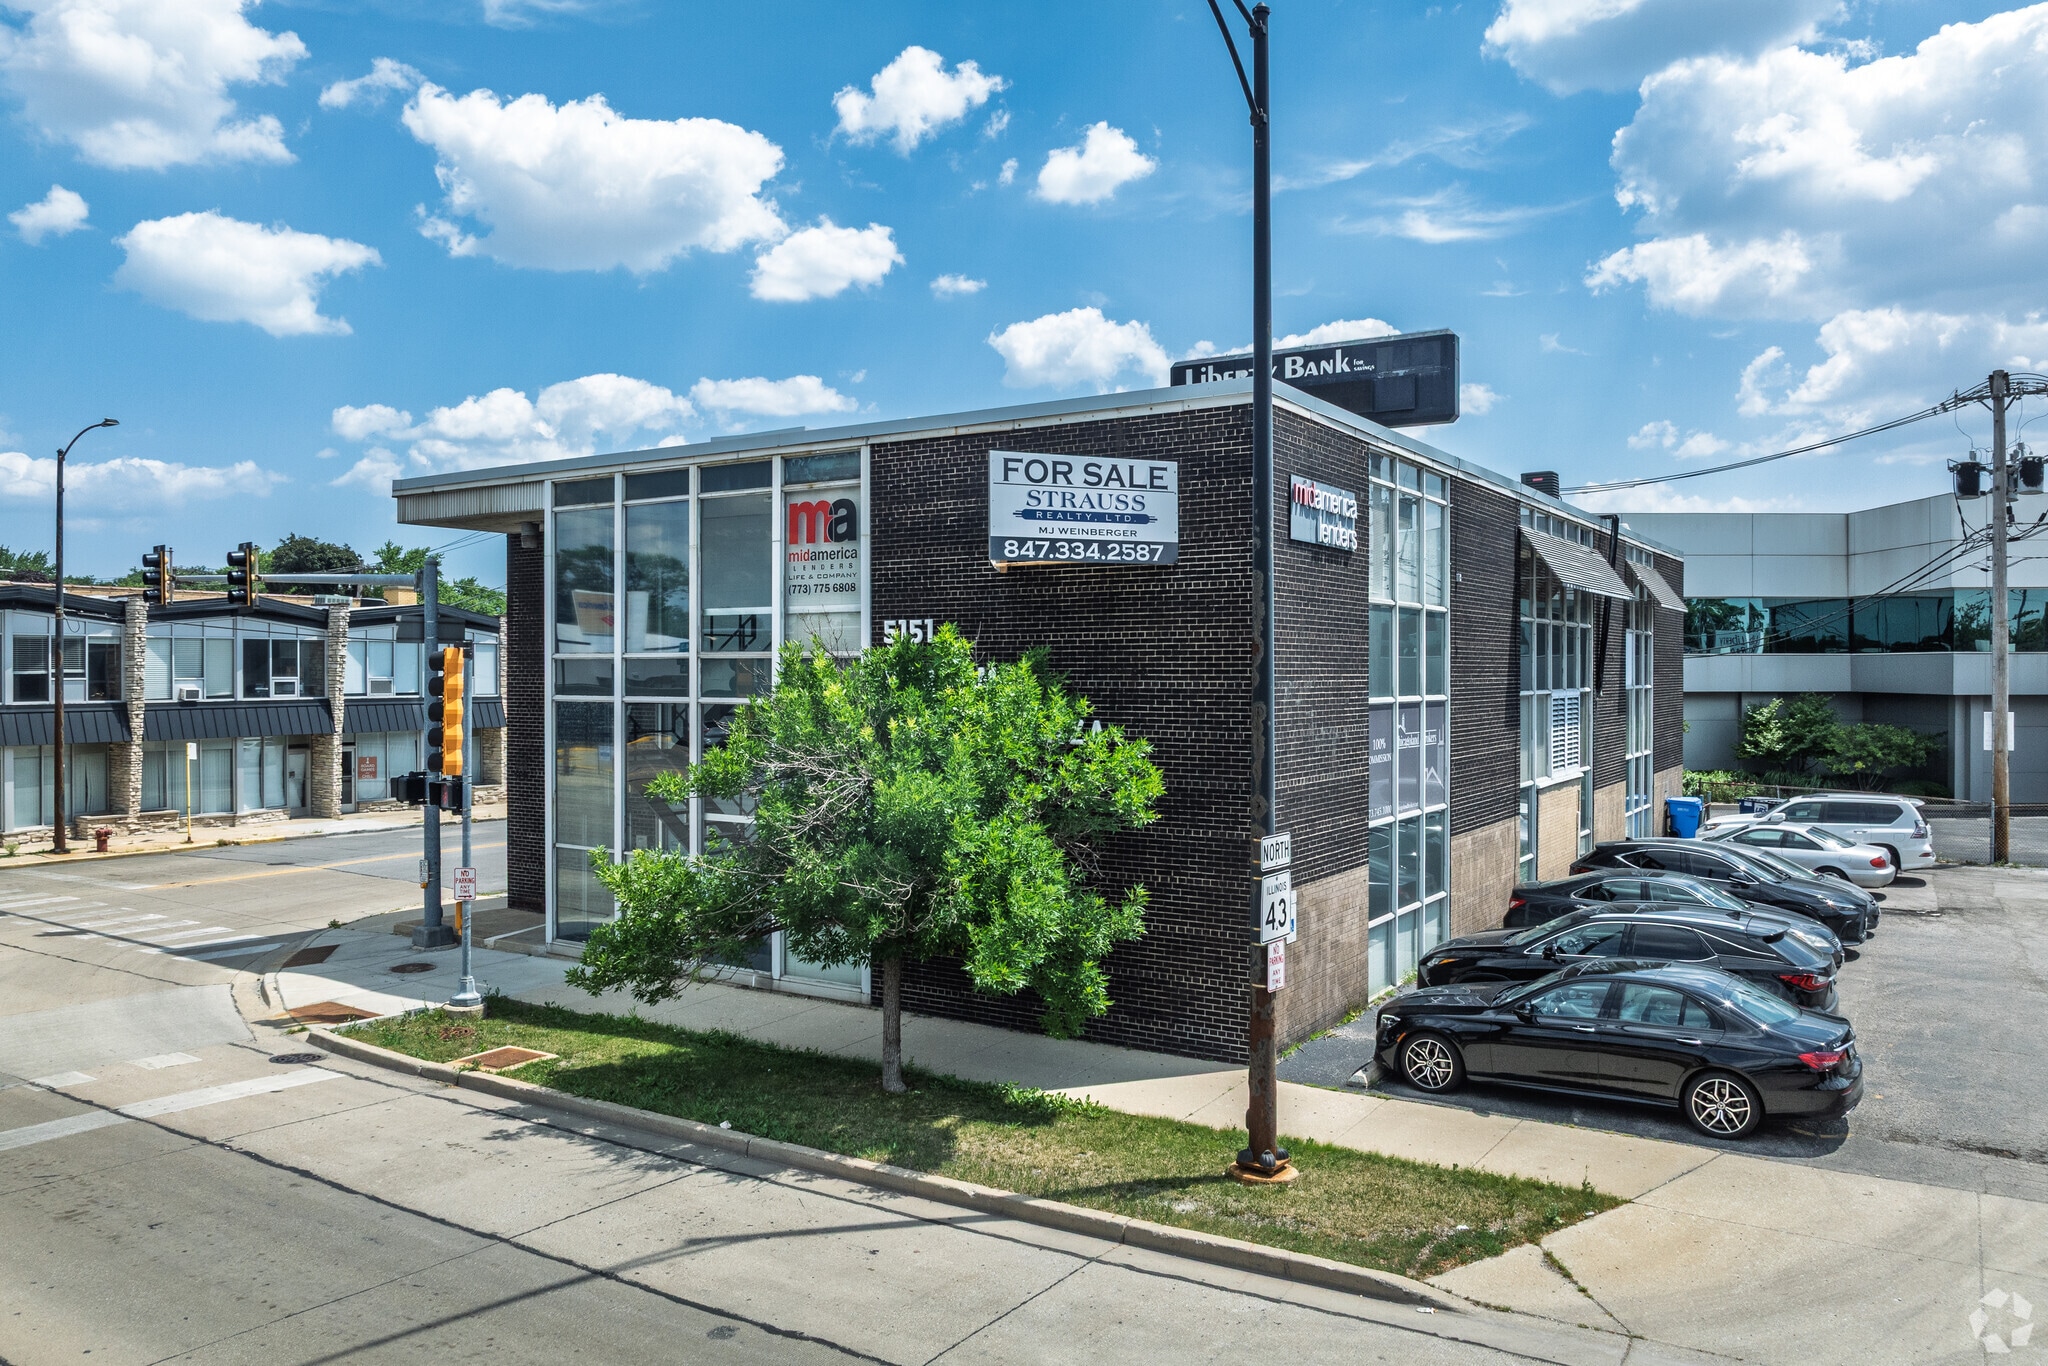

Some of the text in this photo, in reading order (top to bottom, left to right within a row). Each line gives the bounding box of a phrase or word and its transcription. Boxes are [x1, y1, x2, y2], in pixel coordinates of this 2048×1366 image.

[1002, 457, 1169, 490] FOR SALE
[1026, 489, 1146, 512] STRAUSS
[1293, 480, 1358, 519] midamerica
[1036, 511, 1137, 523] REALTY, LTD.
[1038, 526, 1138, 537] MJ WEINBERGER
[1319, 516, 1358, 550] lenders
[788, 547, 858, 562] midamerica
[1003, 539, 1164, 562] 847.334.2587
[793, 562, 853, 572] LENDERS
[788, 582, 856, 595] (773) 775 6808
[883, 618, 934, 645] 5151
[1263, 839, 1290, 863] NORTH
[1266, 881, 1287, 896] ILLINOIS
[1265, 898, 1287, 931] 43
[1273, 944, 1280, 955] NO
[1269, 954, 1284, 966] PARKING
